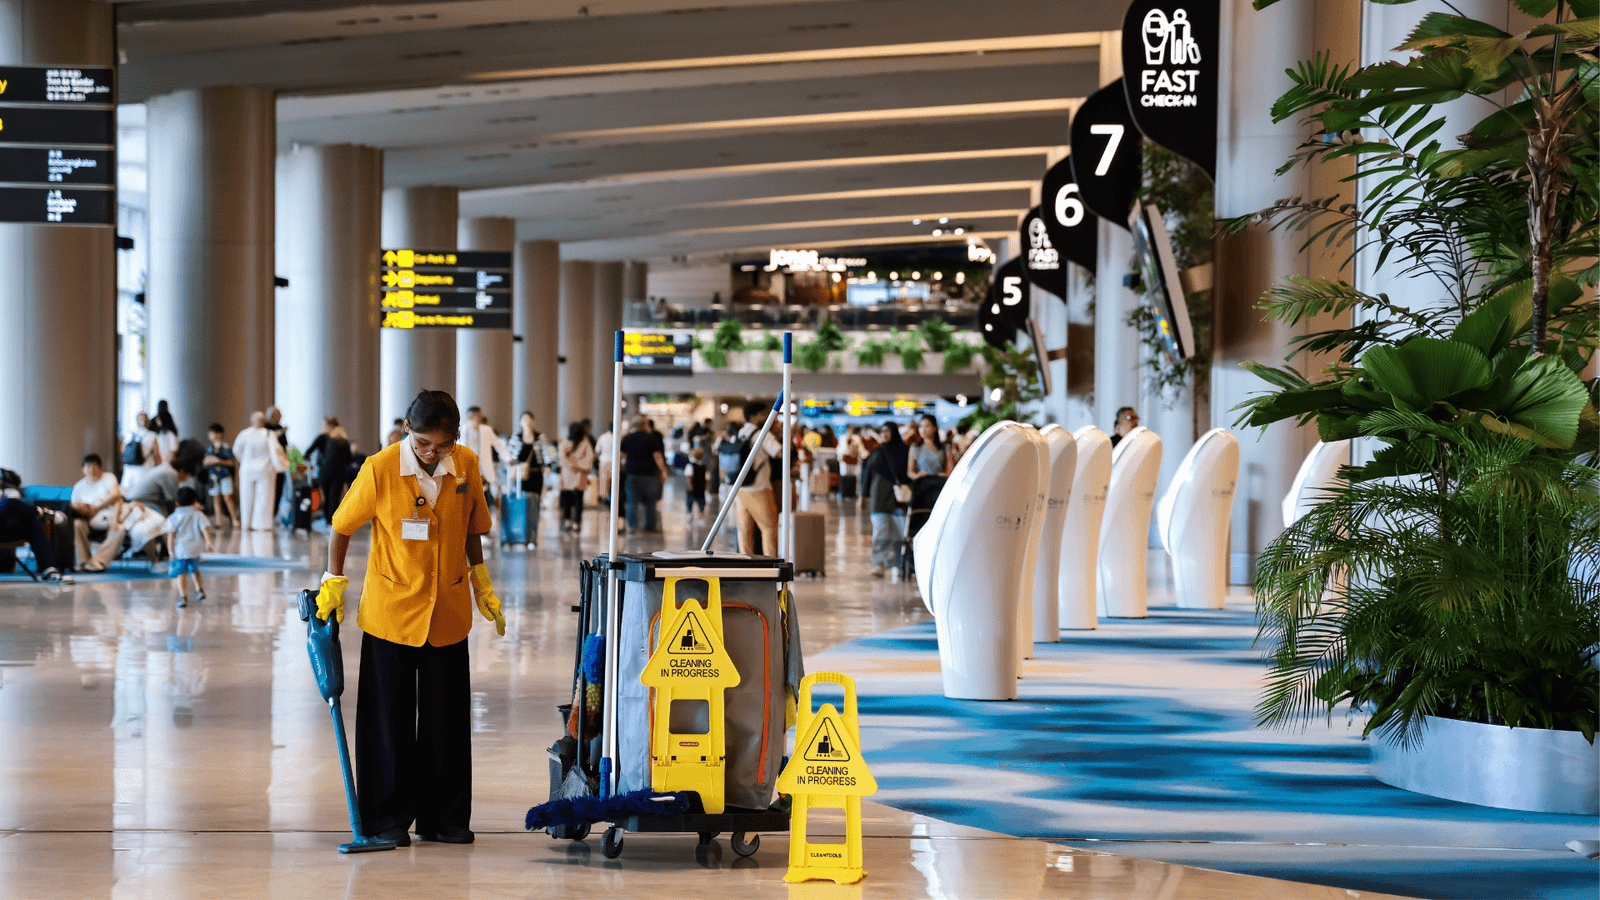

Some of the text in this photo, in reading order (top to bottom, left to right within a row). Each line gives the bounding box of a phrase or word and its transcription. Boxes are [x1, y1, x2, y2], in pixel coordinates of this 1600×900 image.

[1141, 69, 1200, 93] FAST
[1140, 94, 1198, 107] CHECK-IN
[1090, 124, 1125, 176] 7
[1055, 183, 1084, 227] 6
[1002, 276, 1022, 306] 5
[670, 659, 712, 668] CLEANING
[661, 669, 720, 678] IN PROGRESS
[806, 766, 849, 775] CLEANING
[797, 776, 856, 786] IN PROGRESS
